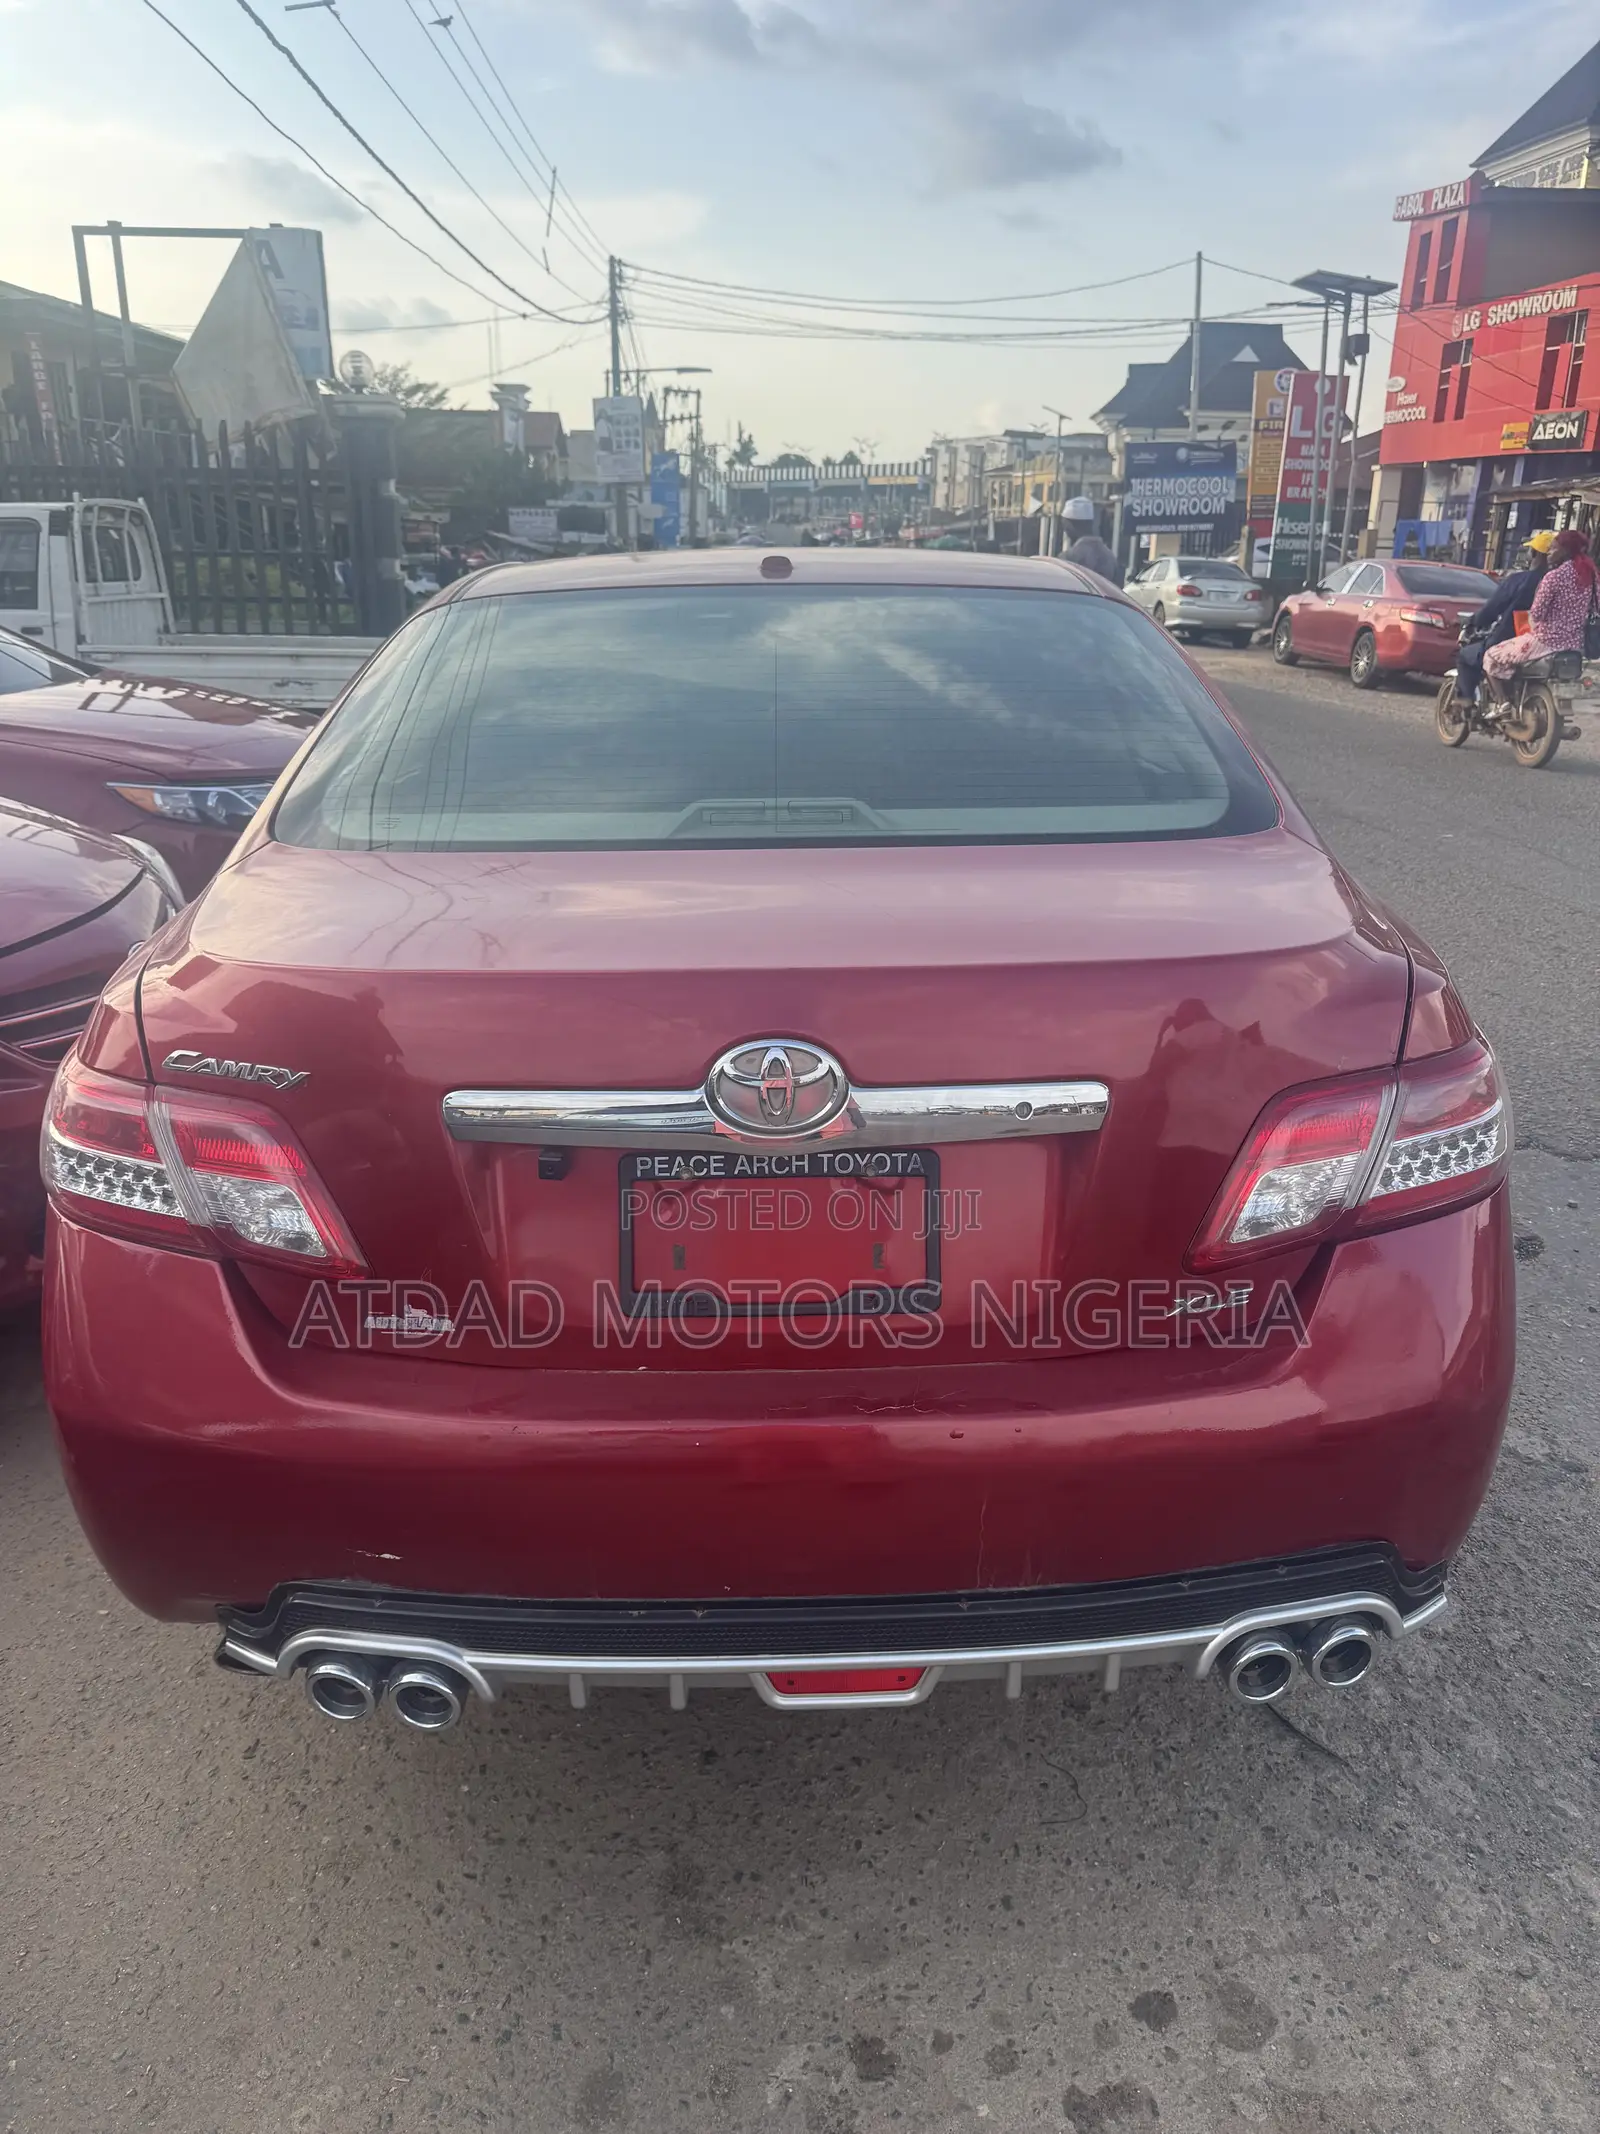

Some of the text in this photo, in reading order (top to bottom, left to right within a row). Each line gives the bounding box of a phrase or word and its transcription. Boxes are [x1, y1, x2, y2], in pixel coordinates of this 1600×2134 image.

[1431, 183, 1465, 211] PLAZA
[1462, 285, 1579, 333] LG SHOWROOM
[1532, 420, 1579, 441] AEON
[1131, 477, 1228, 497] THERMOCOOL
[1132, 496, 1226, 517] SHOWROOM
[161, 1049, 311, 1090] CAMRY
[636, 1152, 925, 1178] PEACE ARCH TOYOTA
[1166, 1286, 1254, 1318] XLE
